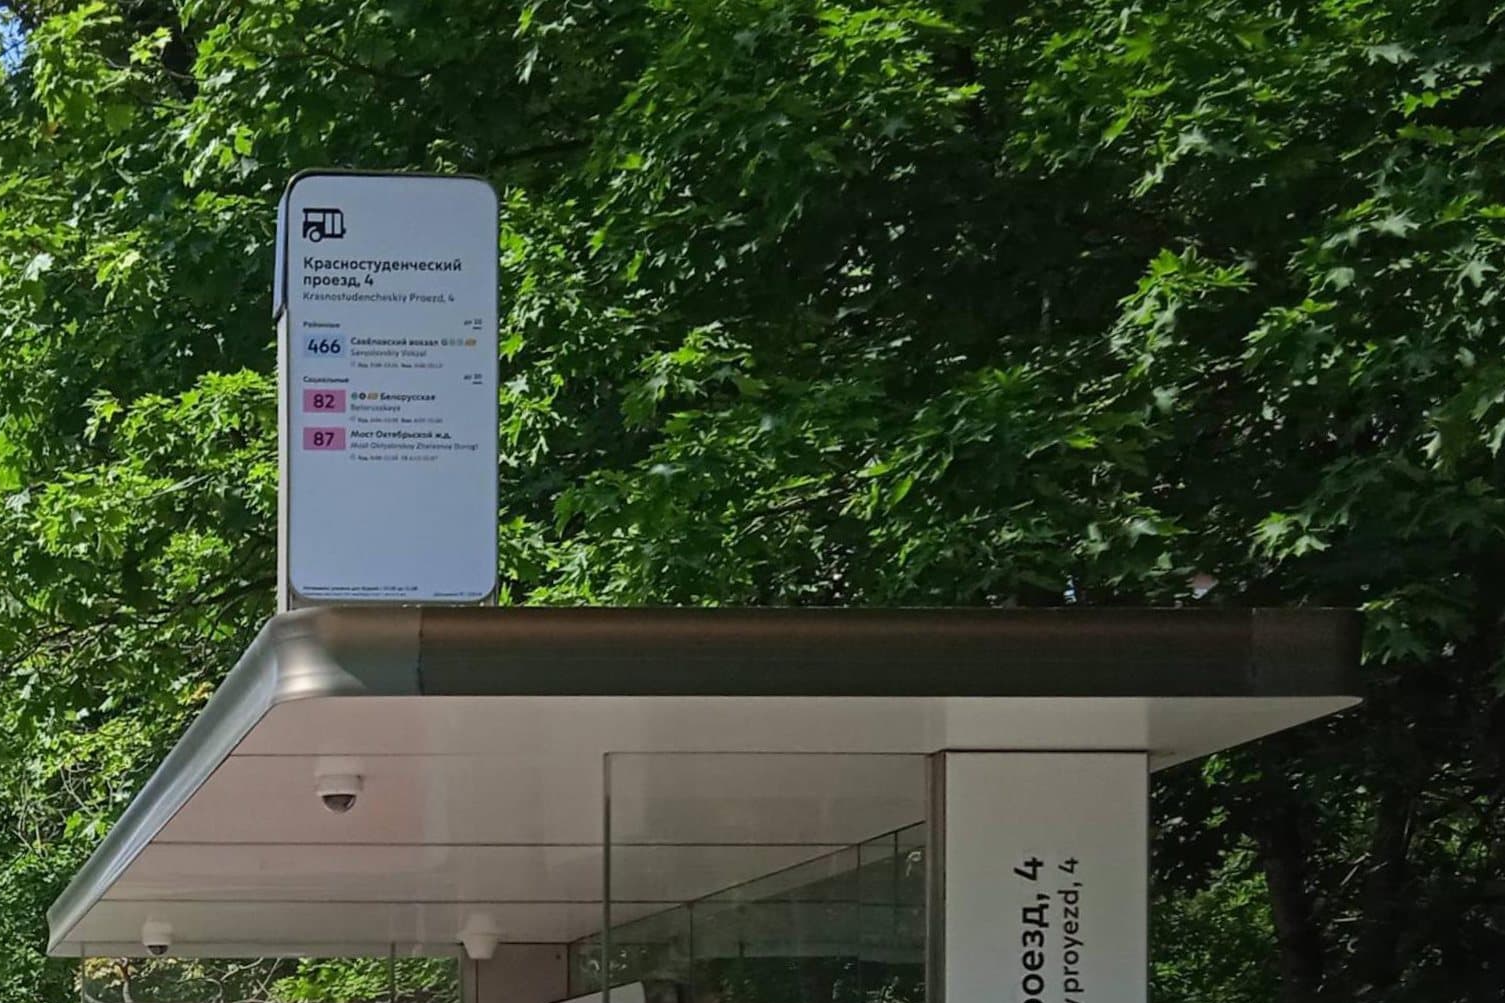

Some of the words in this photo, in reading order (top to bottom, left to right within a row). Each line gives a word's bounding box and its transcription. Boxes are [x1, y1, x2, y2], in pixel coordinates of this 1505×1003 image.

[303, 256, 462, 273] Красностуденческий
[303, 275, 361, 288] проезд,
[364, 274, 374, 286] 4
[307, 338, 342, 354] 466
[313, 393, 335, 409] 82
[313, 431, 335, 447] 87
[1013, 857, 1044, 881] 4
[1058, 857, 1079, 874] 4
[1057, 882, 1084, 993] proyezd,
